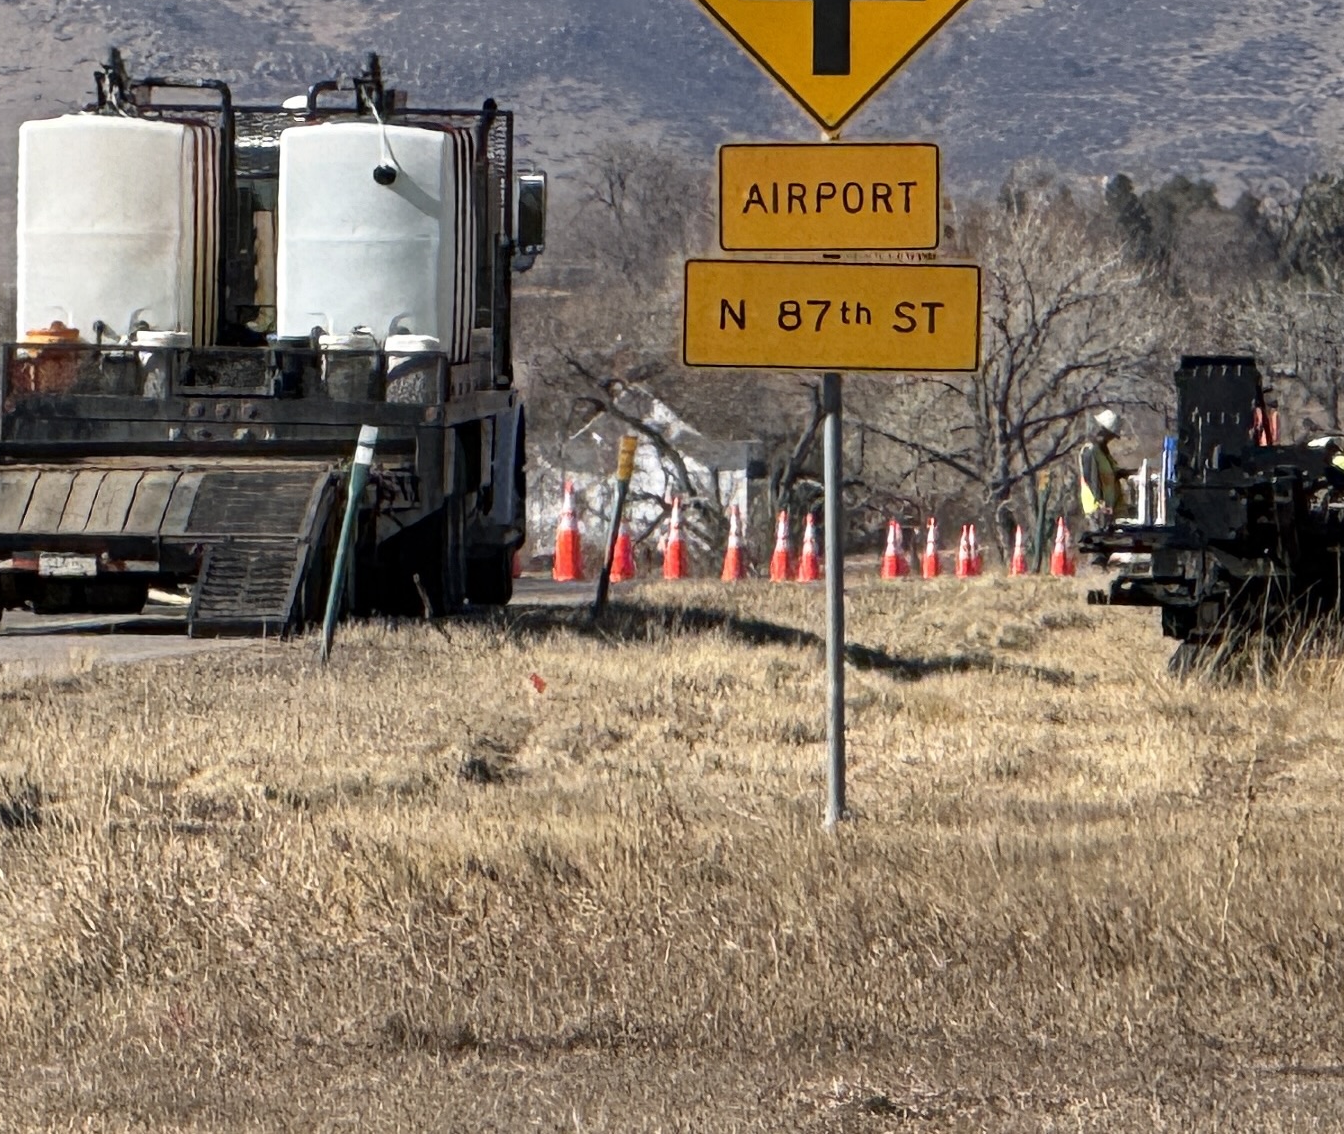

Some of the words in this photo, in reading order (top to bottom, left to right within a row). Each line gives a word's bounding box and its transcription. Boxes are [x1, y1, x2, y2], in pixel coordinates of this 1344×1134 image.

[742, 181, 918, 214] AIRPORT
[719, 298, 746, 331] N
[777, 299, 873, 333] 87th
[892, 301, 945, 334] ST
